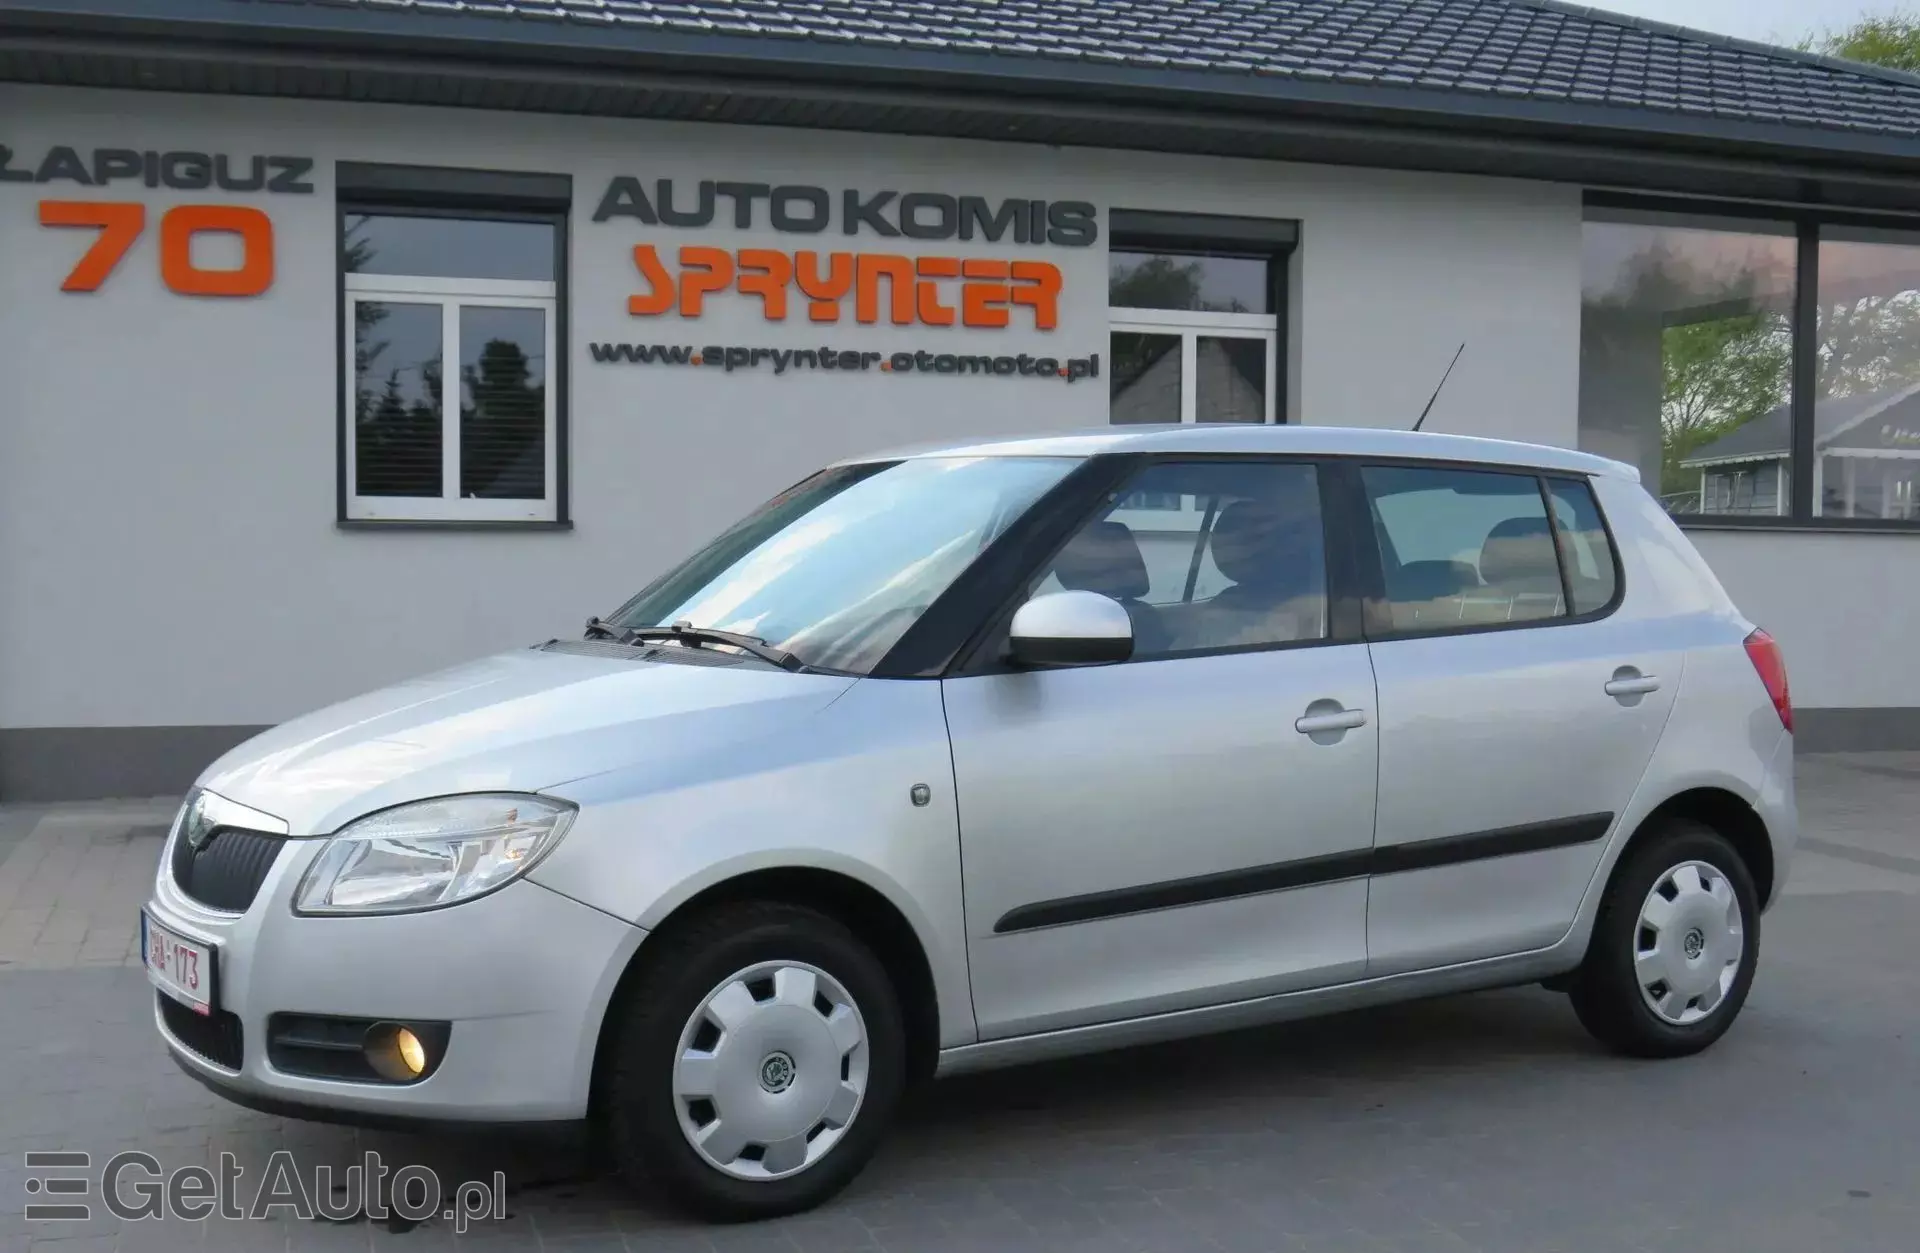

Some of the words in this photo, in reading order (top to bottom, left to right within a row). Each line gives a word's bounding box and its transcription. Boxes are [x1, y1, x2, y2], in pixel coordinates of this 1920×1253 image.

[39, 200, 274, 297] 70
[593, 176, 830, 233] AUTO
[843, 188, 1097, 246] KOMIS
[628, 244, 1063, 330] SPRYNTER
[589, 342, 1099, 384] www.sprynter.otomoto.pl
